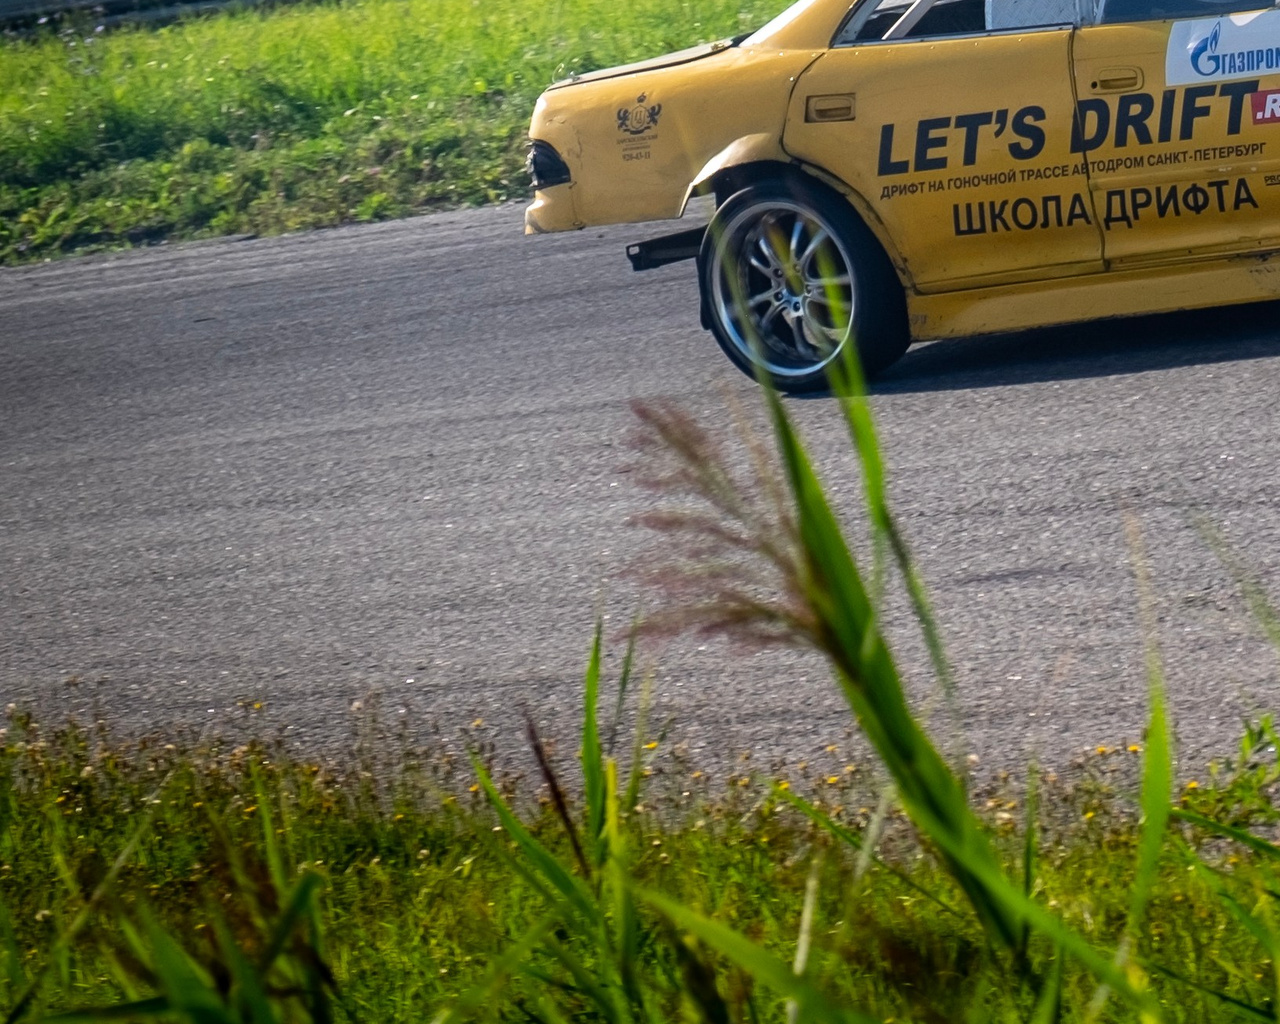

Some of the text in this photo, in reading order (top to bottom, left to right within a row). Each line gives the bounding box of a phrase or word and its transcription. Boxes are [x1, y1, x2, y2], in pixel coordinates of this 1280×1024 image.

[877, 105, 1046, 176] LET'S
[1069, 80, 1260, 154] DRIFT
[880, 142, 1267, 200] ДРИФТ НА ГОНОЧНОЙ ТРАССЕ АВТОДРОМ САНКТ-ПЕТЕРБУРГ
[953, 177, 1259, 236] ШКОЛА ДРИФТА
